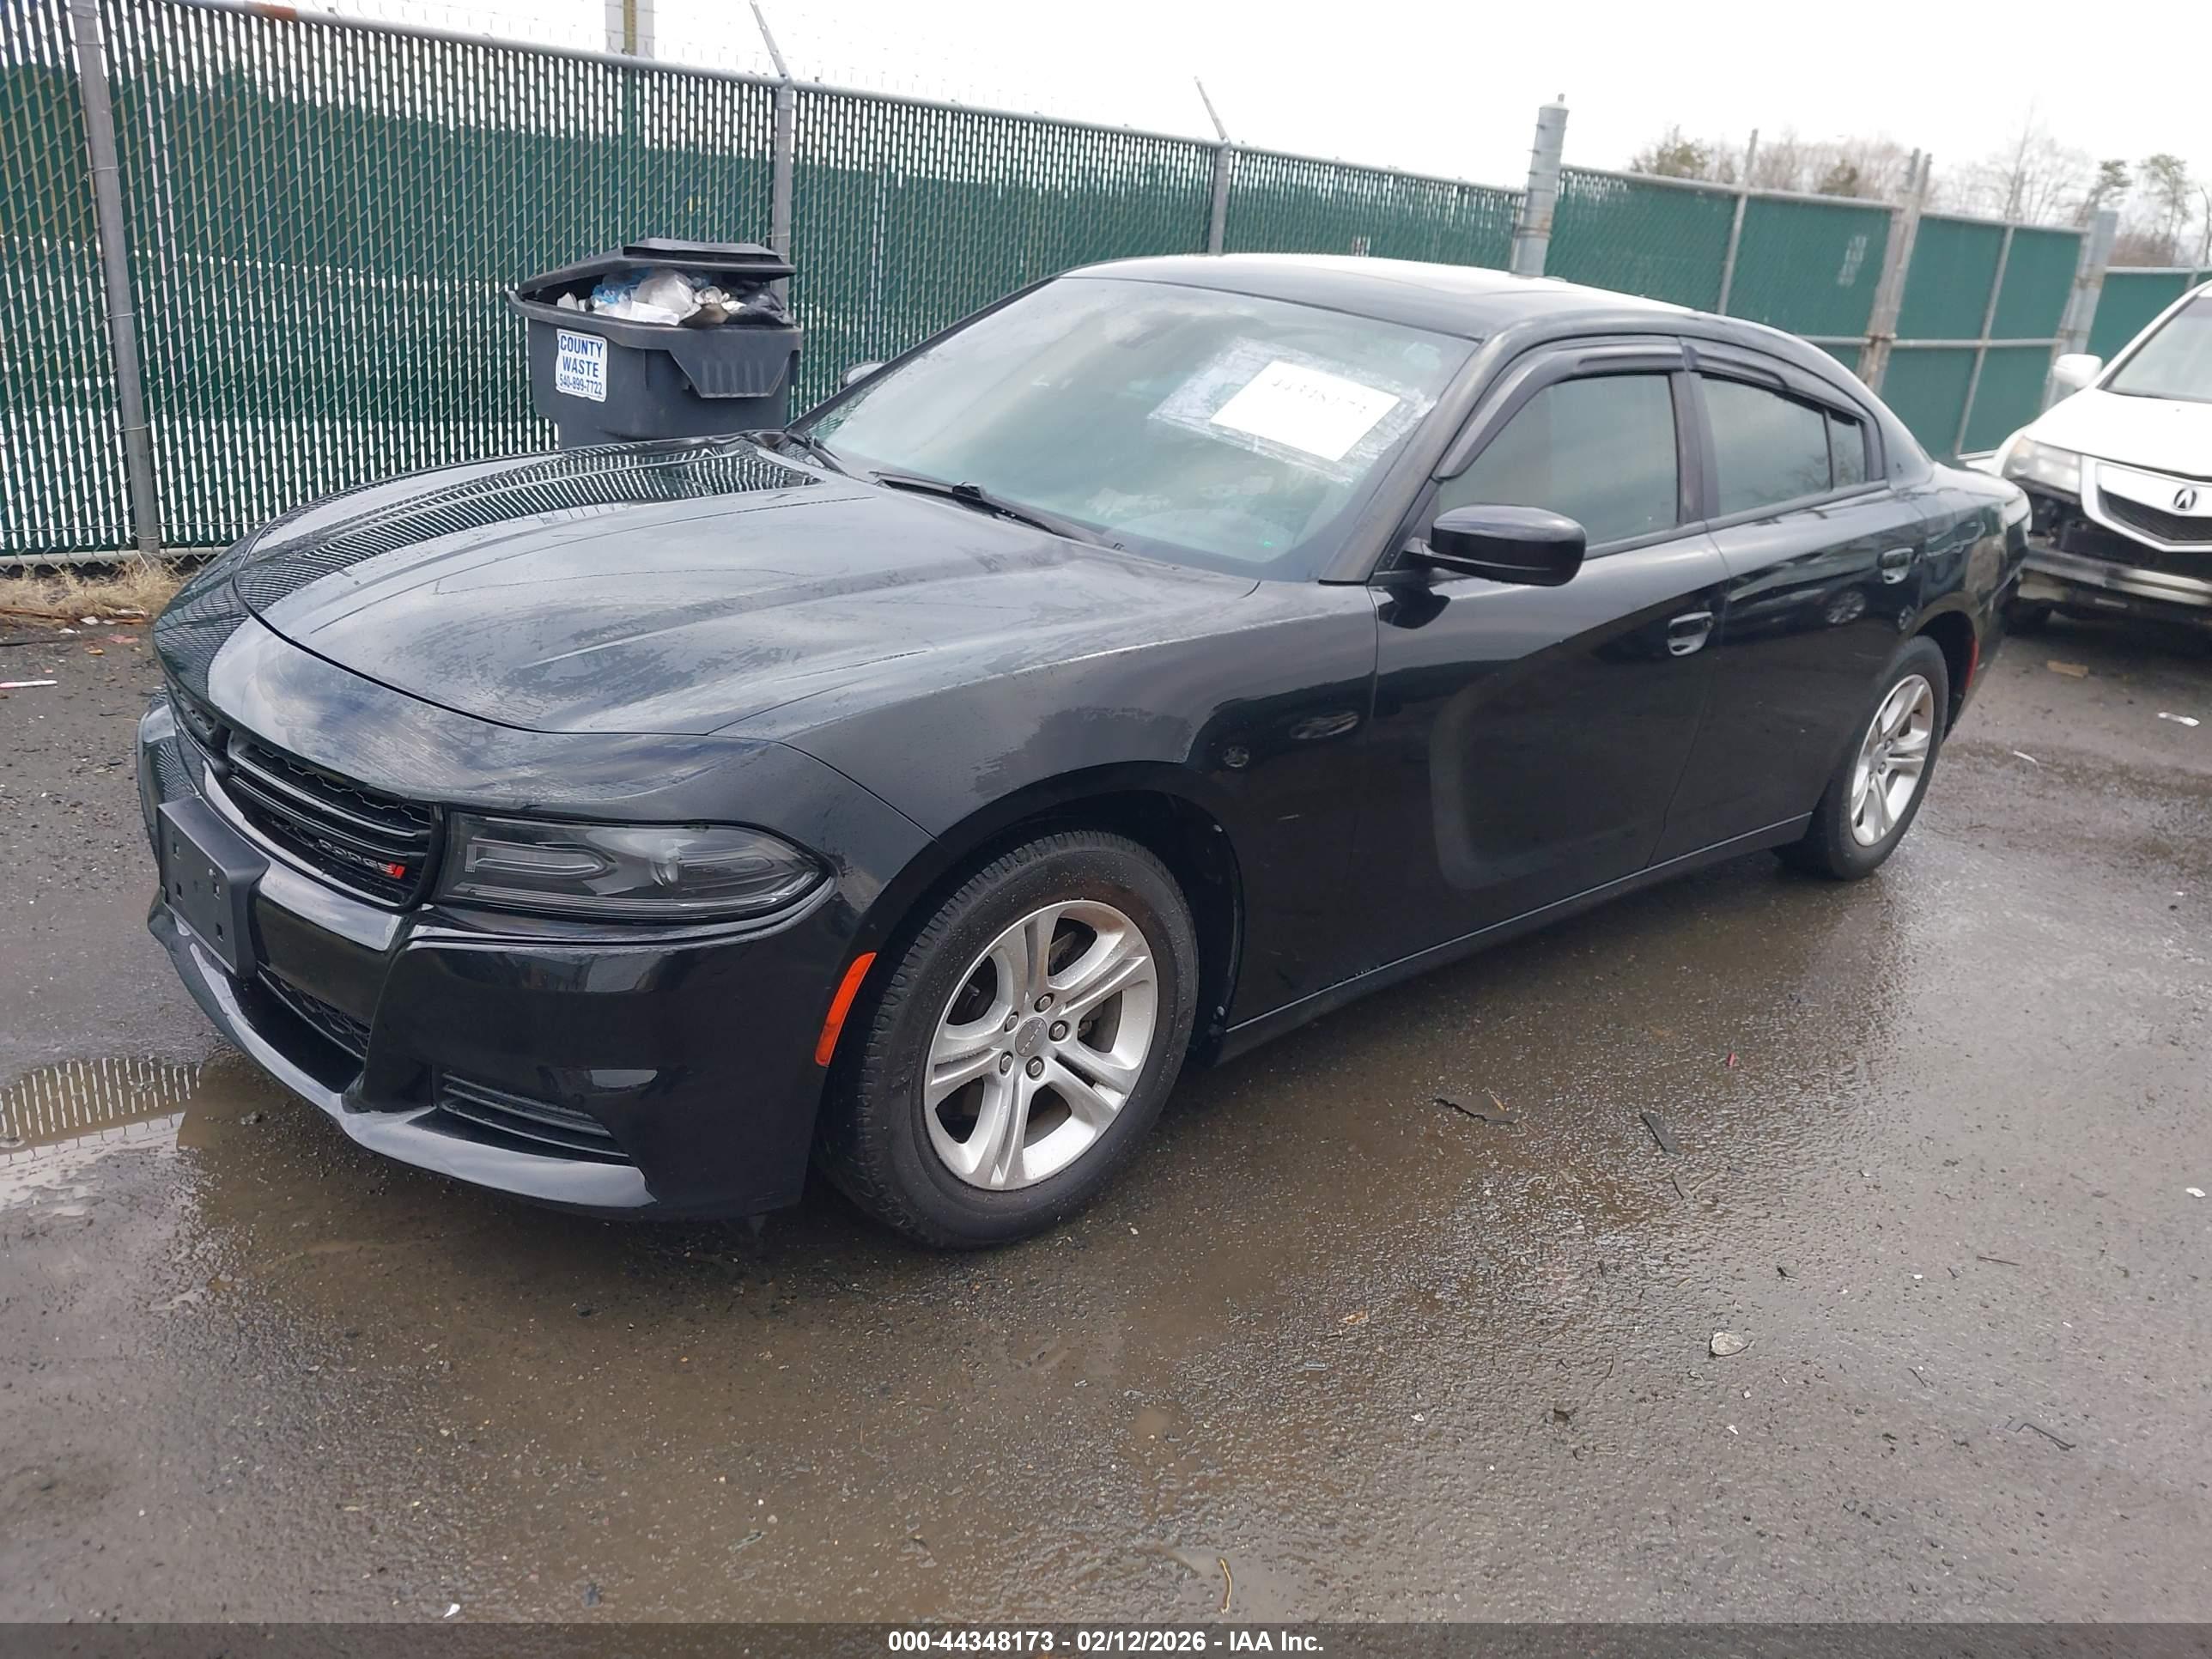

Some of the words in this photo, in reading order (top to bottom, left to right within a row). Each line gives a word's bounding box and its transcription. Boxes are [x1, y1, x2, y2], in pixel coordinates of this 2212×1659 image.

[560, 335, 603, 358] COUNTY
[562, 356, 599, 378] WASTE
[319, 838, 394, 874] DODGE
